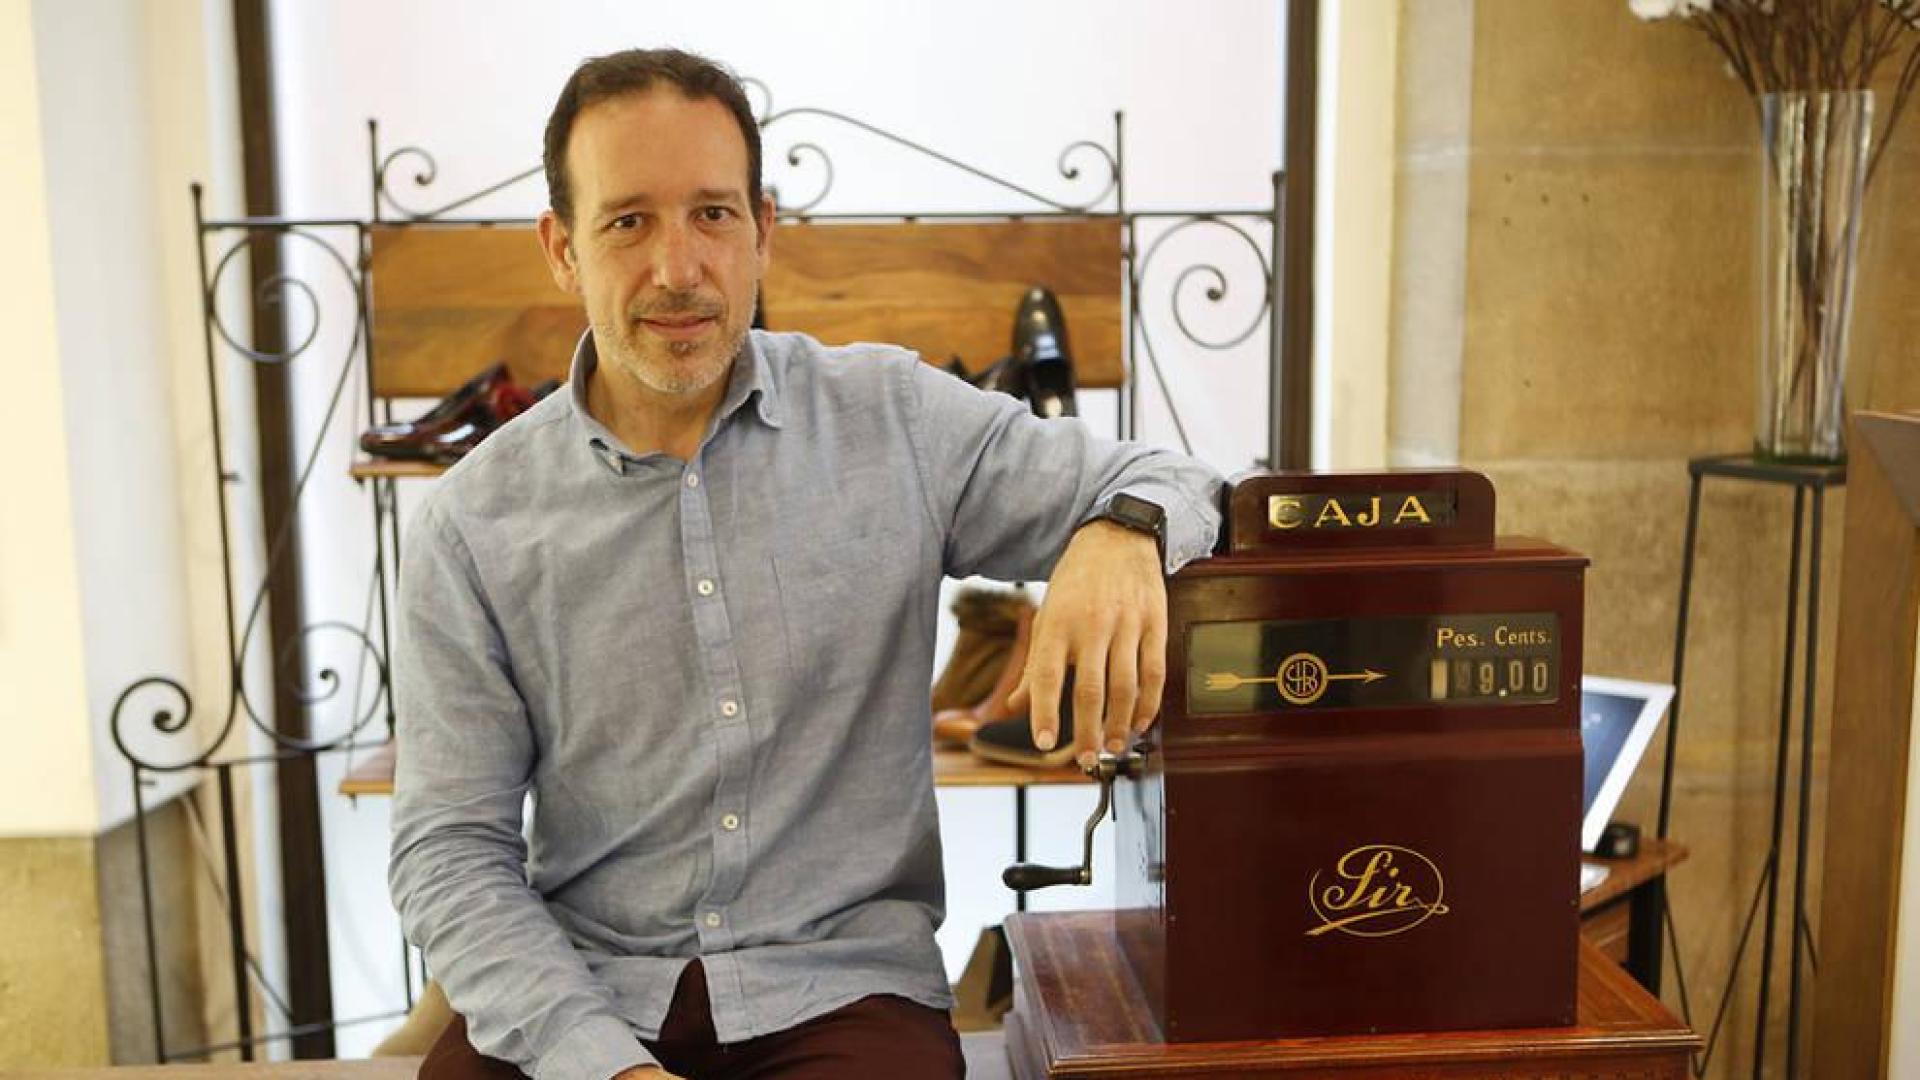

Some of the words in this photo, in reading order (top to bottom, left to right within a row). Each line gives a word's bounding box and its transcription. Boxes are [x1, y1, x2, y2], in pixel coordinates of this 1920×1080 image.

[1270, 496, 1431, 529] CAJA
[1437, 627, 1485, 648] Pes.
[1495, 625, 1552, 646] Cents.
[1304, 845, 1449, 937] Sir
